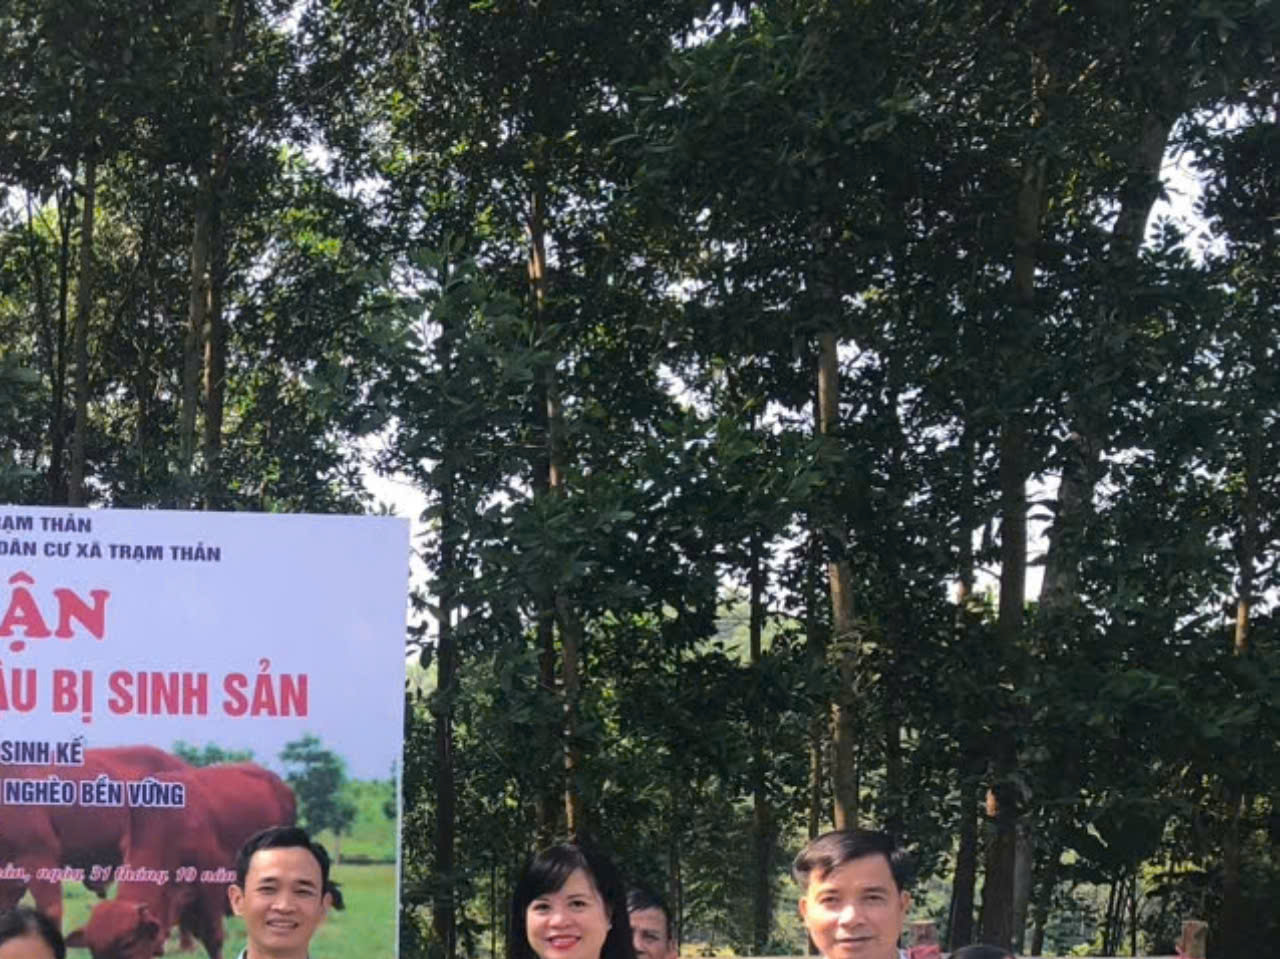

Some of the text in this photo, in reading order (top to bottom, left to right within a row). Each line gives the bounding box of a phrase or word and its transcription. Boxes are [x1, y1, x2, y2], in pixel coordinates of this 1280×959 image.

[44, 542, 72, 558] CƯ
[76, 541, 102, 559] XÃ
[109, 544, 164, 562] TRẠM
[52, 668, 93, 723] BỊ
[108, 671, 208, 717] SINH
[222, 657, 309, 718] SẢN
[0, 740, 50, 763] SINH
[56, 735, 84, 764] KẾ
[6, 776, 75, 804] NGHÈO
[129, 779, 184, 806] VỮNG
